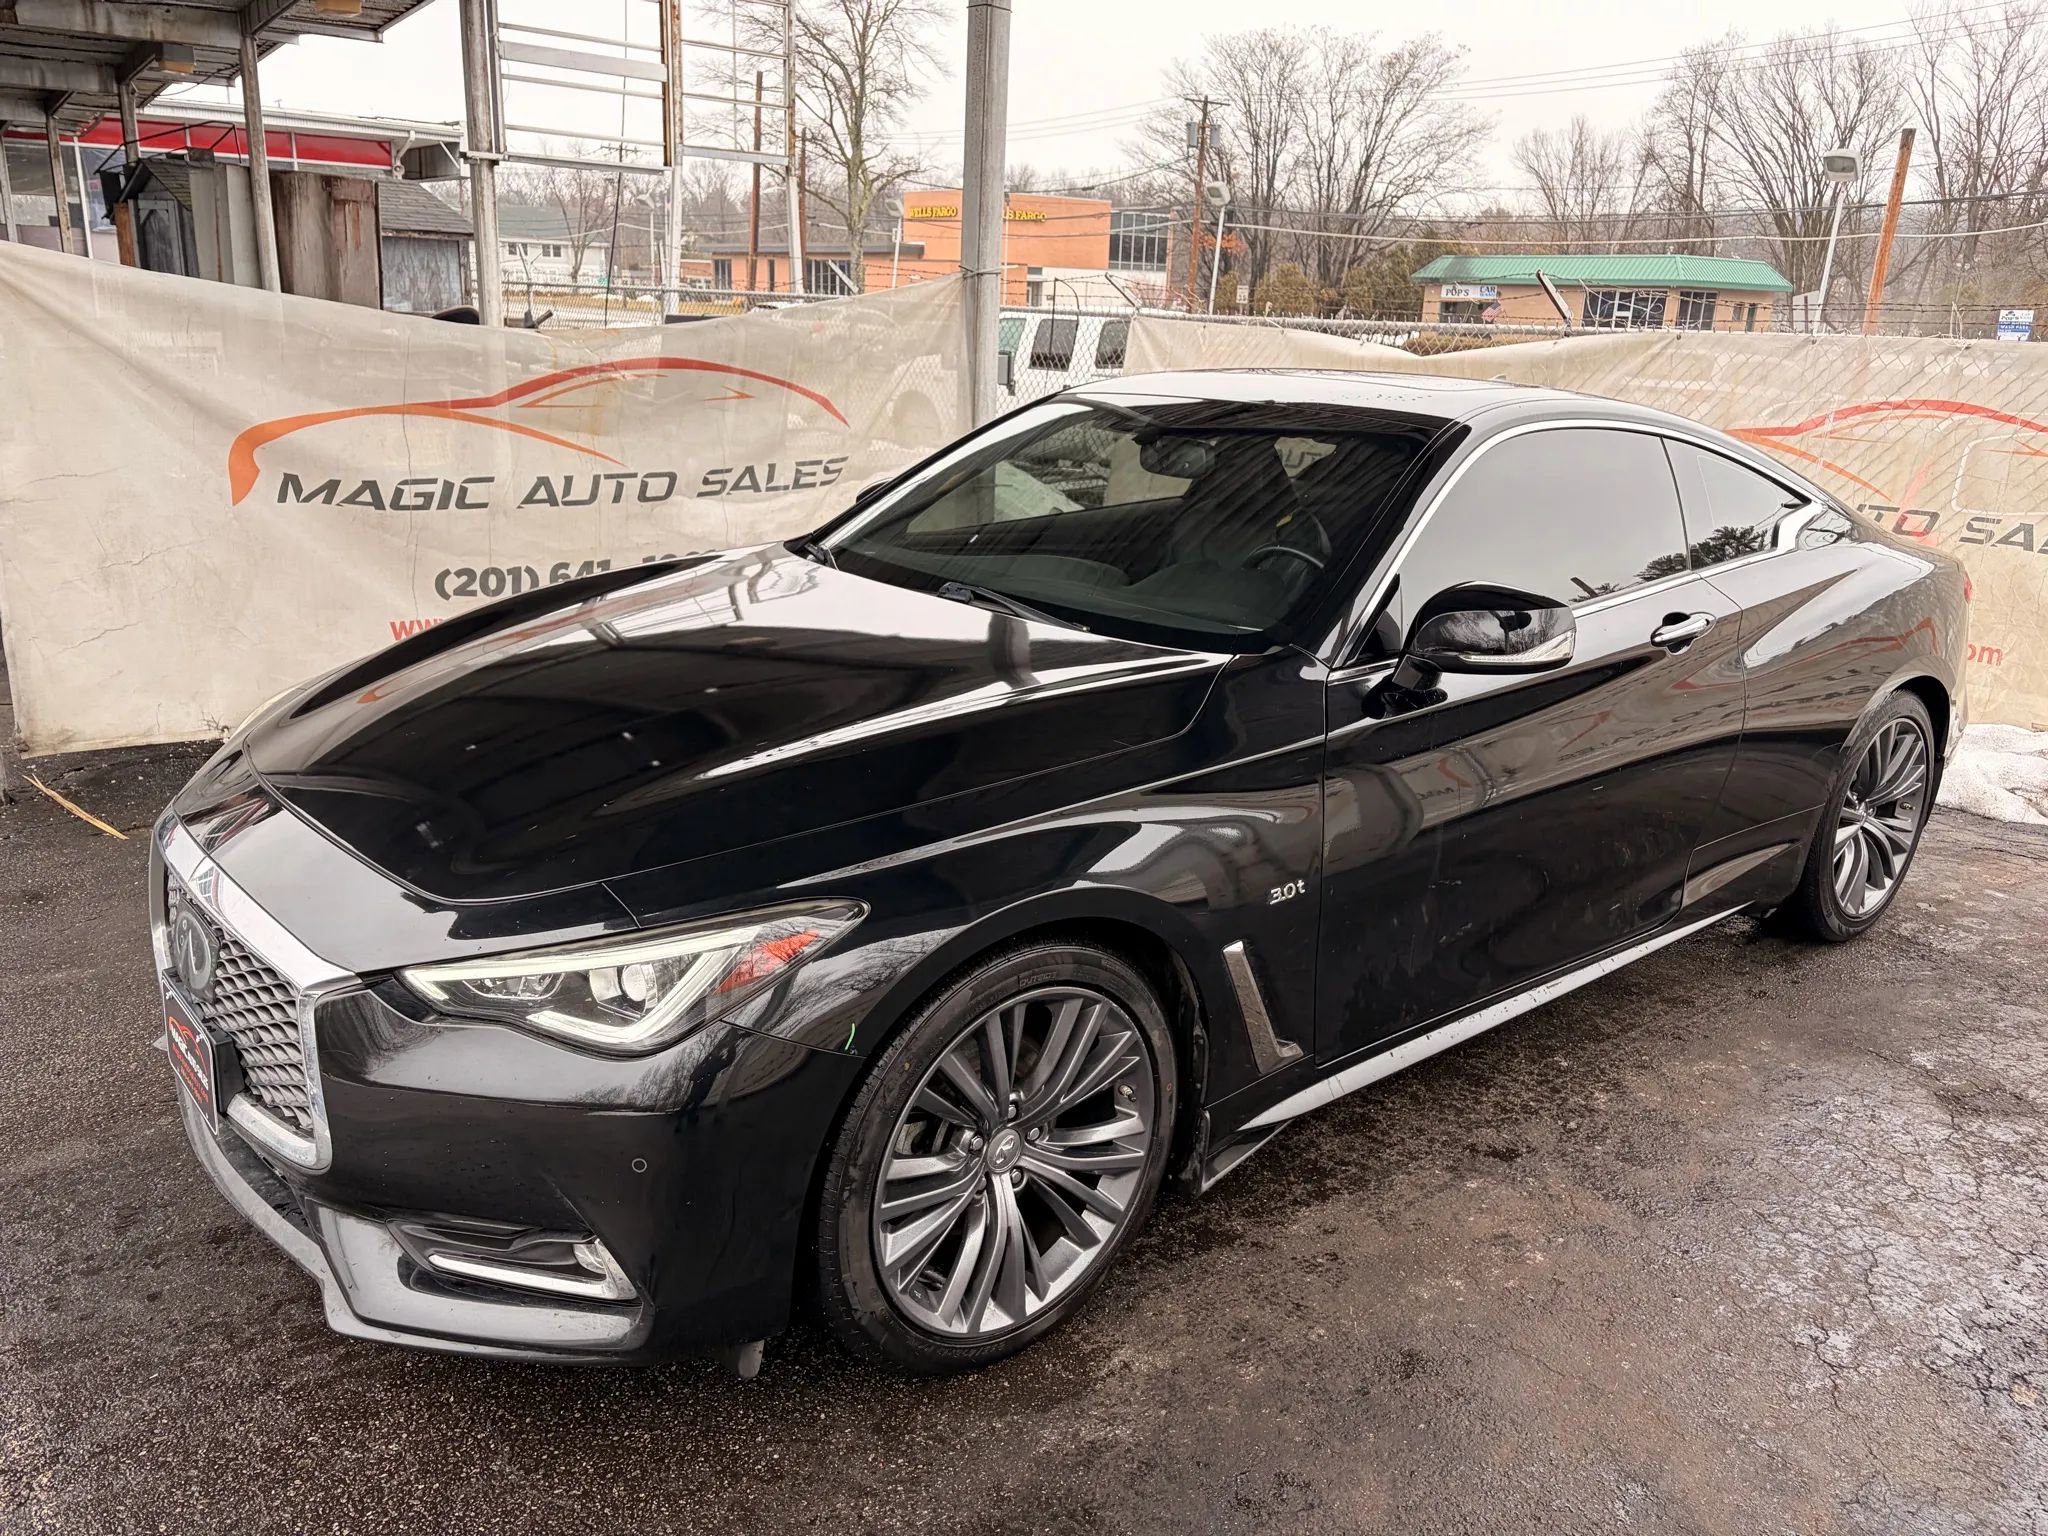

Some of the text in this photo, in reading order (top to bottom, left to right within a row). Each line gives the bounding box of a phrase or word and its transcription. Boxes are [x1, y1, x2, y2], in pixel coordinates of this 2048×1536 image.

[909, 206, 957, 217] WELLS FARGO
[1015, 210, 1047, 222] FARGO
[277, 456, 849, 511] MAGIC AUTO SALES
[434, 565, 540, 601] (201)
